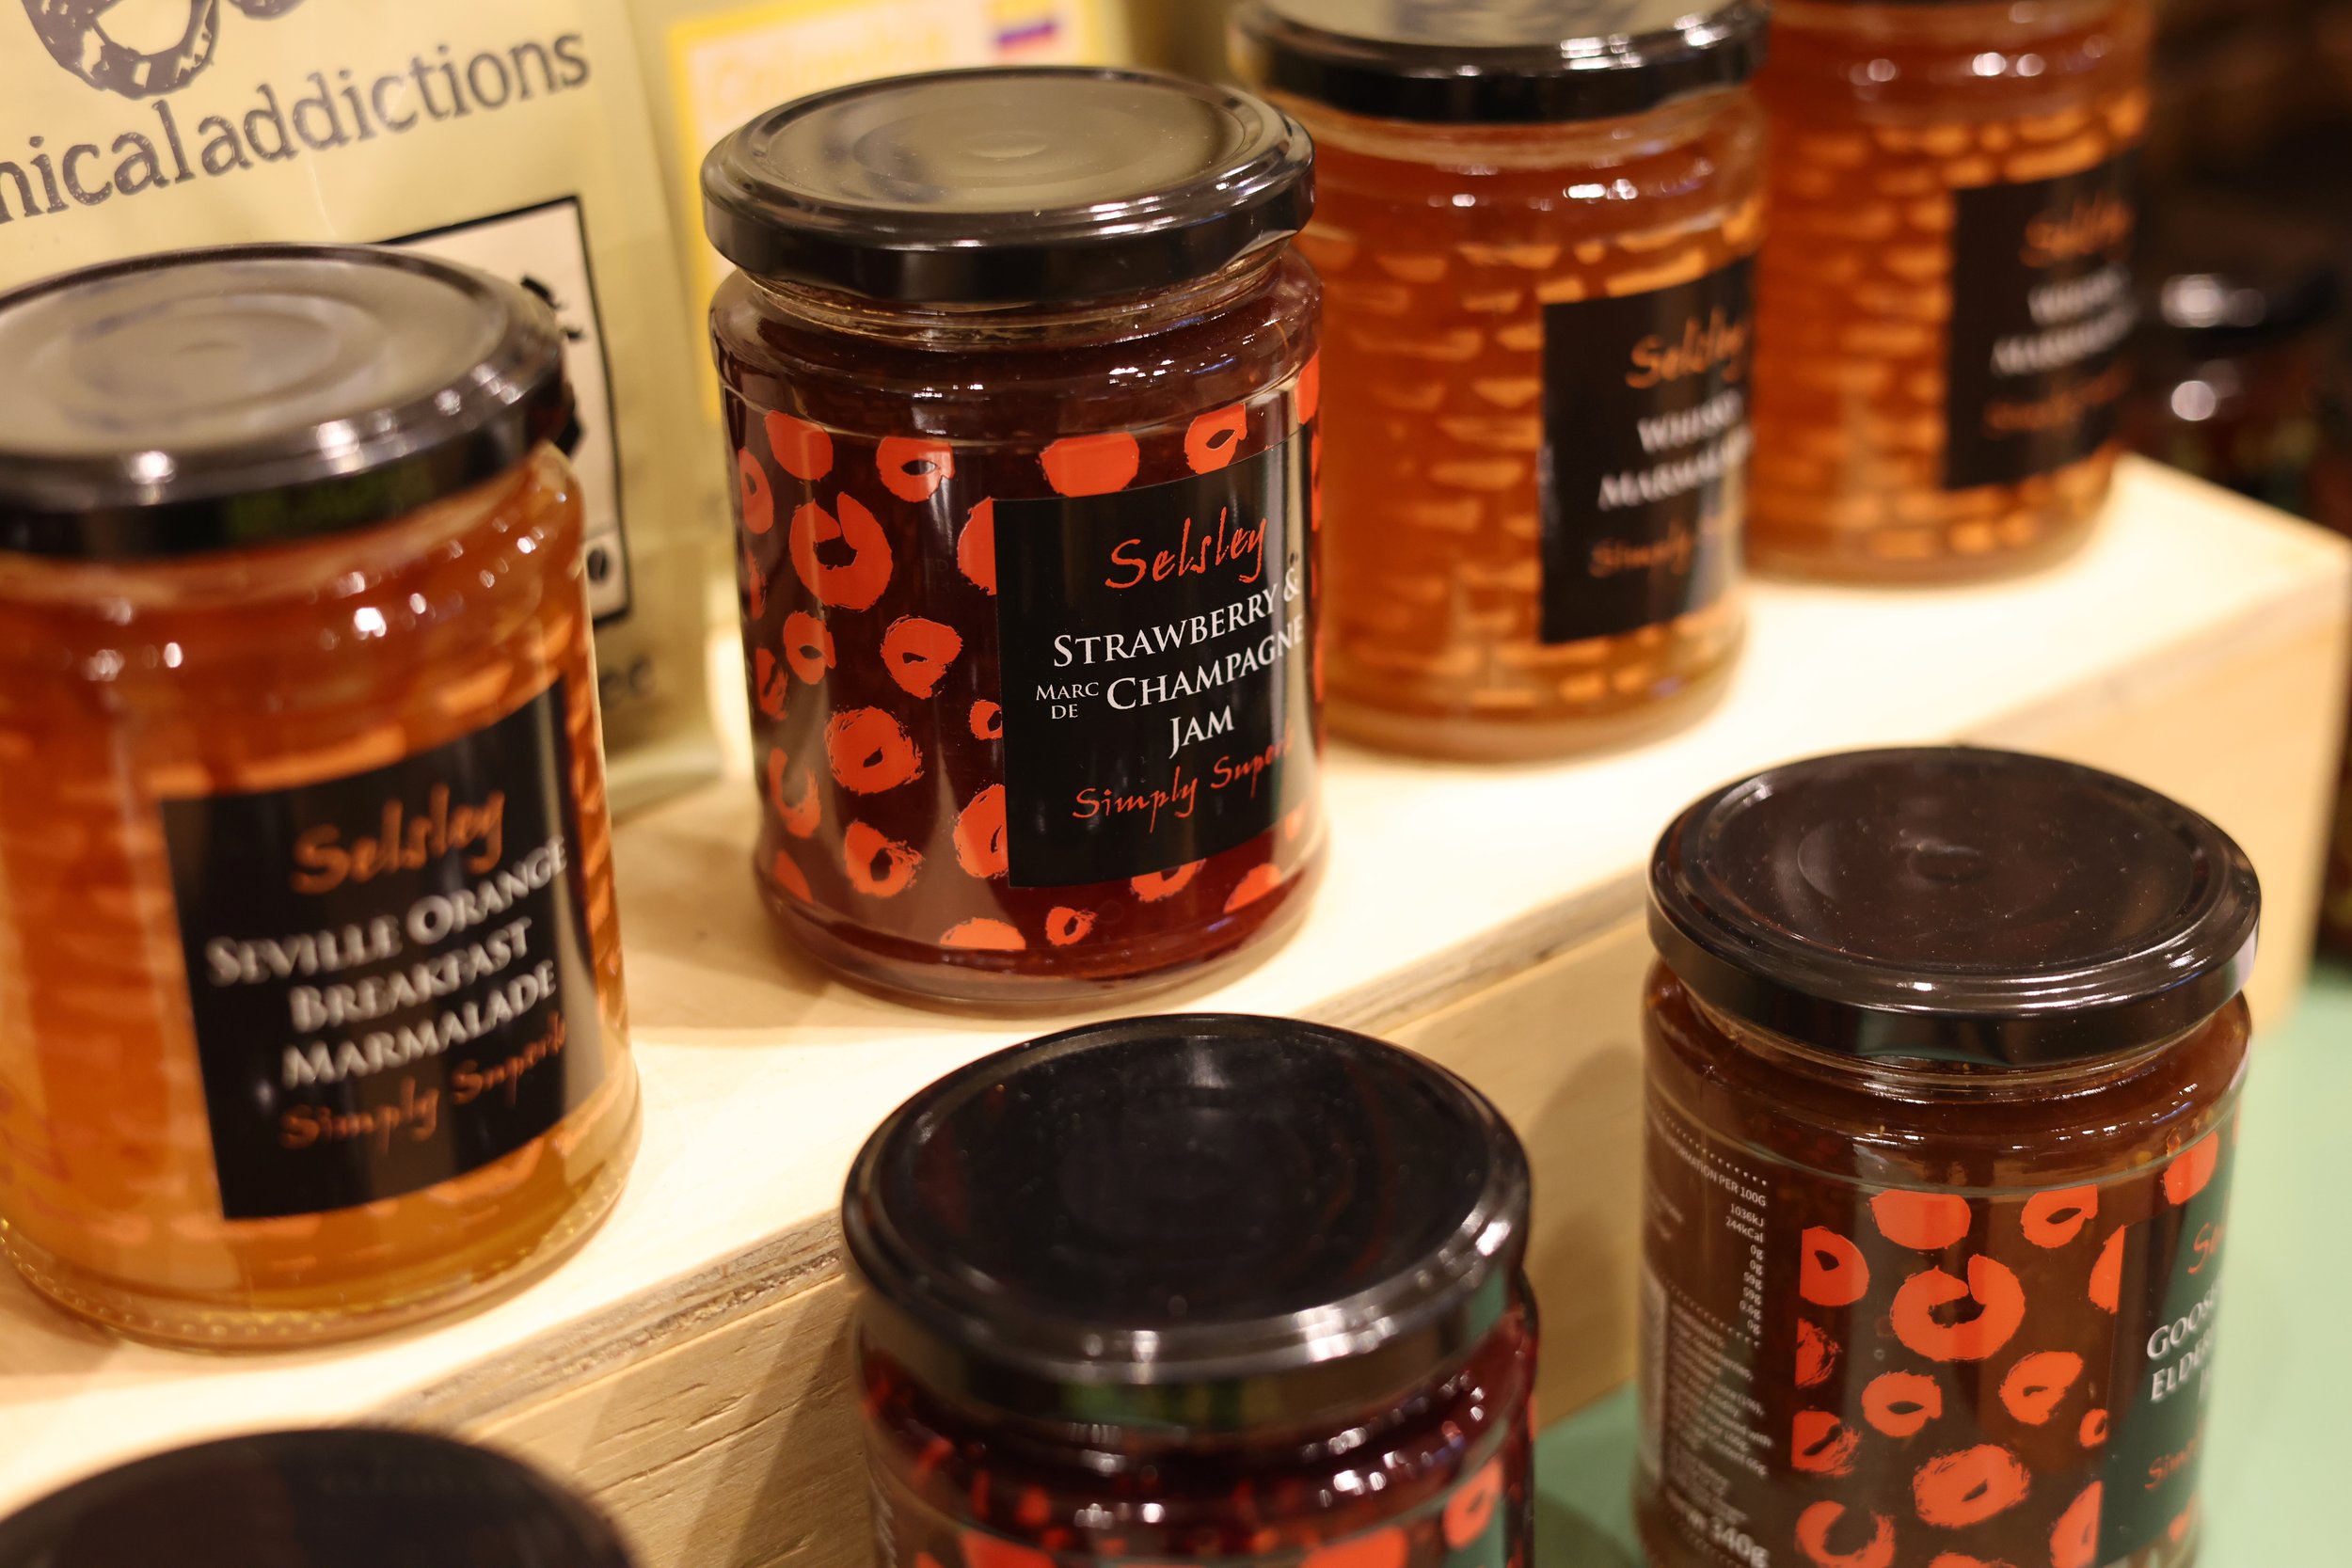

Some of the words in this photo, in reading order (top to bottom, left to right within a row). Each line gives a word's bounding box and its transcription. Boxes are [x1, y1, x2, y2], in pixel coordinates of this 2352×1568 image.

[1104, 506, 1266, 590] Selsley
[1053, 583, 1279, 667] STRAWBERRY
[1283, 567, 1301, 602] &
[1036, 682, 1099, 703] MARC
[1106, 615, 1305, 710] CHAMPAGNE
[1051, 705, 1078, 720] DE
[1168, 705, 1235, 759] JAM
[1072, 766, 1199, 833] Simply
[405, 835, 568, 945] ORANGE
[288, 916, 533, 1034] BREAKFAST
[283, 958, 557, 1090] MARMALADE
[1719, 1174, 1739, 1195] PER
[1740, 1186, 1767, 1208] 100G
[1729, 1203, 1765, 1227] 1036kJ
[1749, 1259, 1763, 1276] 0g
[1750, 1243, 1764, 1261] 0g
